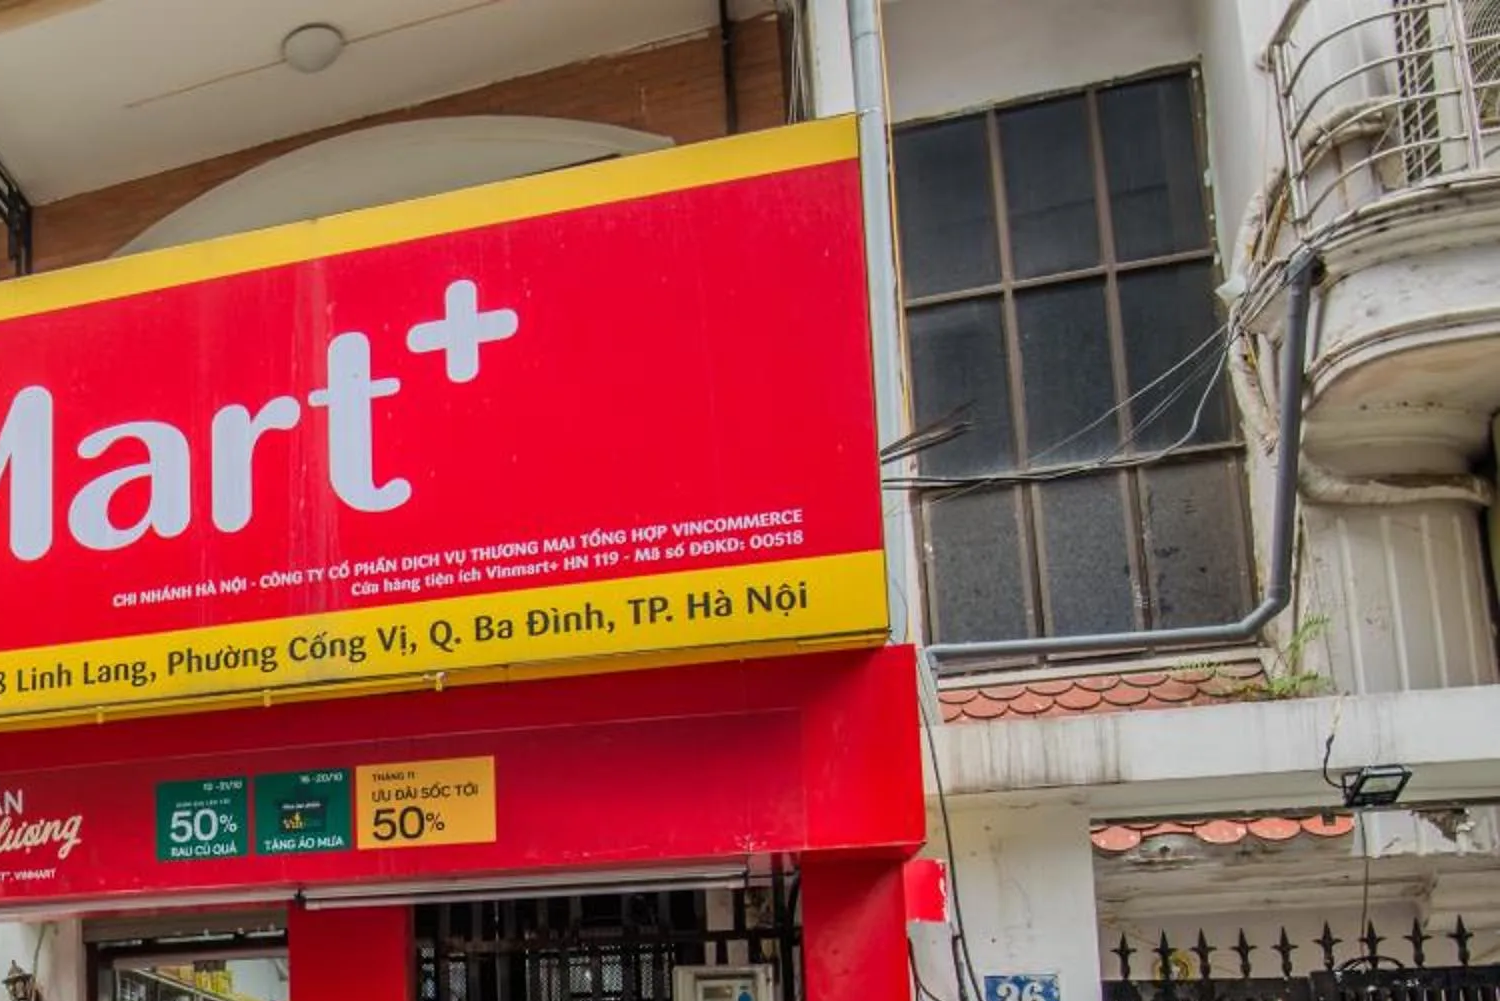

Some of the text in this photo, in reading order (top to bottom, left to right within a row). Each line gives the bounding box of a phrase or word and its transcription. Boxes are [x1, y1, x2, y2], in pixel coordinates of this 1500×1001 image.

[112, 592, 137, 608] CHI
[140, 584, 192, 605] NHÁNH
[195, 580, 217, 597] HÀ
[219, 576, 247, 594] NỘI
[259, 569, 303, 589] CÔNG
[307, 567, 324, 582] TY
[401, 553, 440, 573] DỊCH
[443, 549, 467, 567] VỤ
[470, 540, 538, 562] THƯƠNG
[543, 536, 576, 555] MẠI
[631, 525, 668, 543] HỢP
[672, 508, 803, 538] VINCOMMERCE
[383, 576, 421, 593] hàng
[424, 571, 454, 587] tiện
[458, 567, 482, 583] ích
[486, 559, 559, 580] Vinmart+
[563, 554, 589, 570] HN
[592, 551, 619, 567] 119
[665, 542, 685, 560] số
[749, 529, 804, 550] 00518
[17, 662, 72, 693] Linh
[83, 660, 157, 687] Lang,
[167, 644, 278, 676] Phường
[288, 631, 367, 663] Cống
[376, 625, 418, 656] Vị,
[429, 619, 462, 653] Q.
[474, 614, 514, 642] Ba
[526, 602, 616, 637] Đình,
[628, 596, 673, 625] TP.
[687, 589, 733, 620] Hà
[746, 581, 808, 617] Nội
[421, 782, 451, 799] SỐC
[169, 808, 237, 843] 50%
[373, 805, 445, 841] 50%
